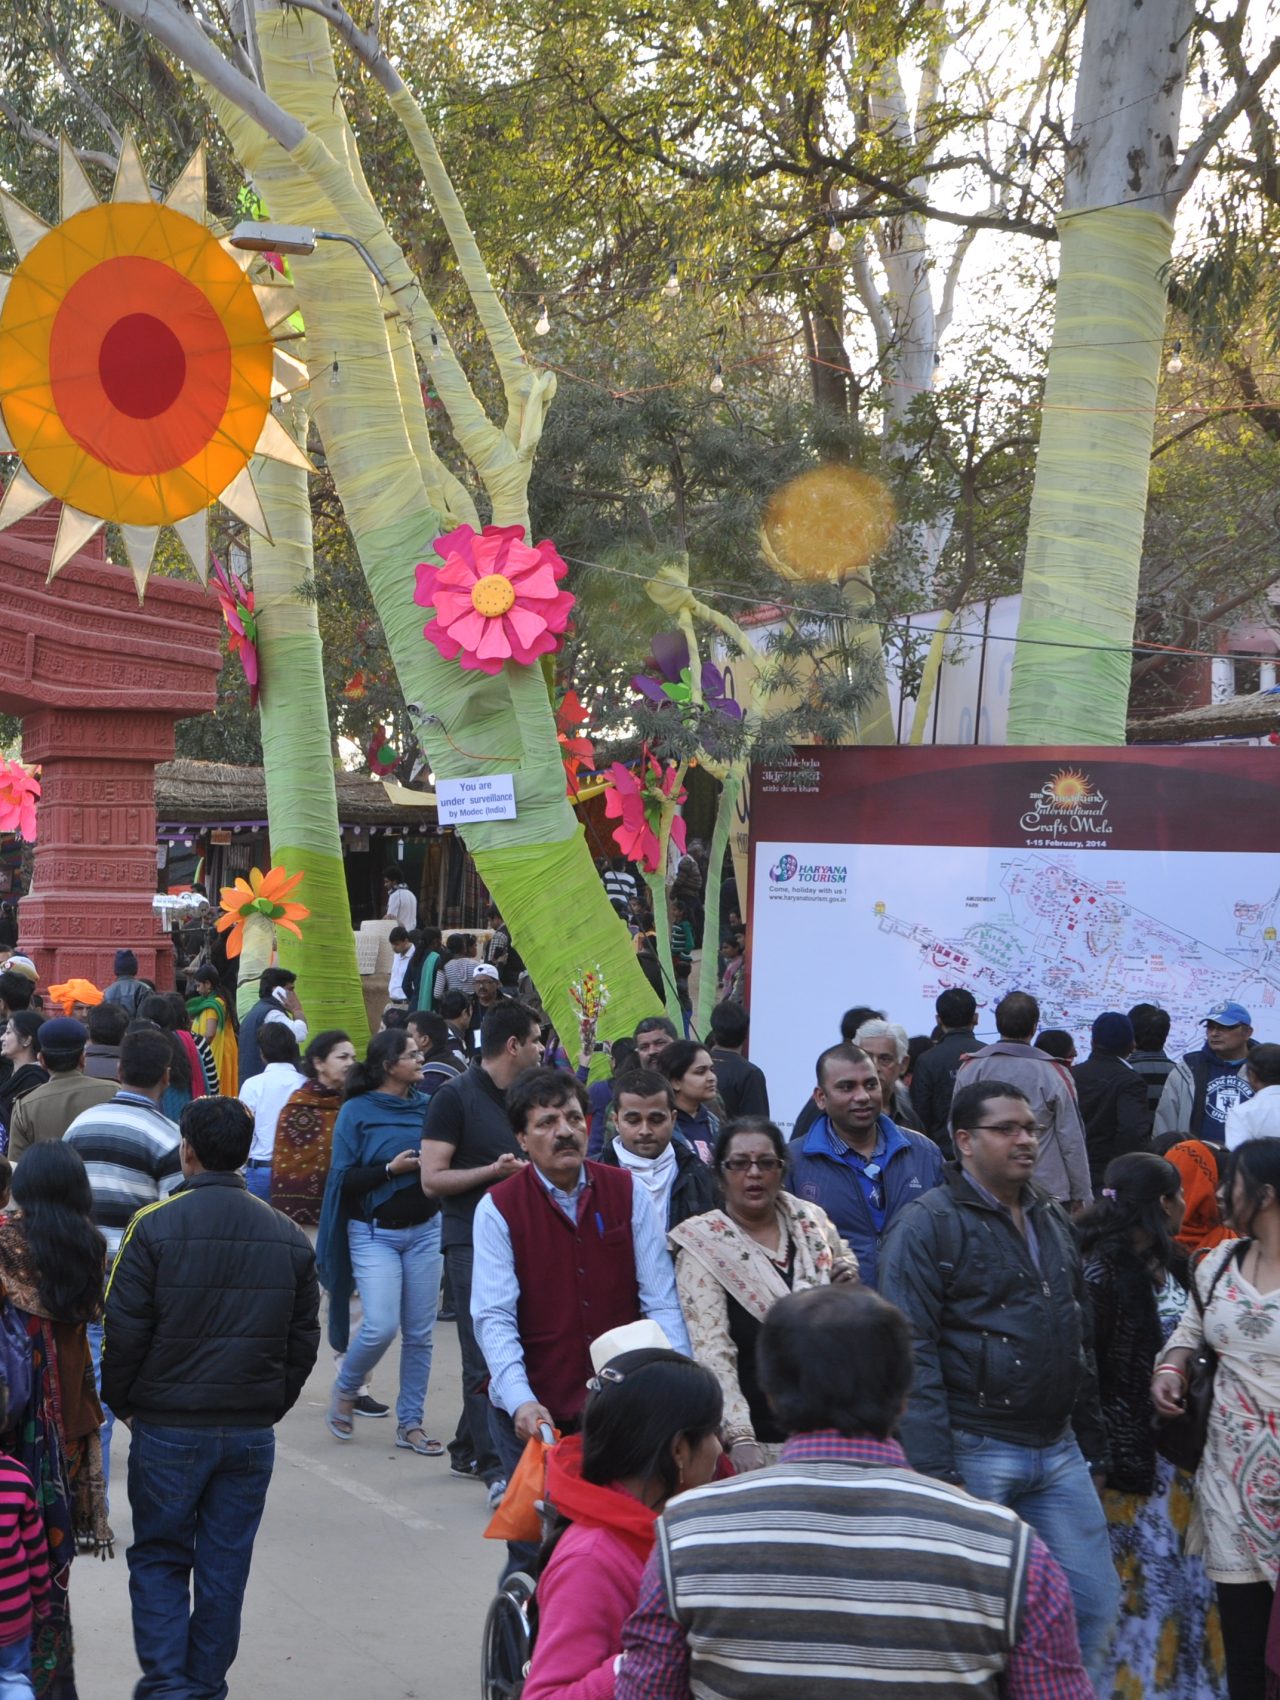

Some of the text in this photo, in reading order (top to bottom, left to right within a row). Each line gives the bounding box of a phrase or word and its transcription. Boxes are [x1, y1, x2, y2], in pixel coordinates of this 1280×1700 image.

[460, 782, 492, 792] You are
[440, 793, 513, 807] under surveillance
[449, 806, 507, 818] by Modec (India)
[1035, 799, 1108, 816] International
[1020, 812, 1113, 839] Crafts Mela
[1026, 839, 1107, 849] 1-15 February, 2014
[799, 865, 848, 875] HARYANA
[799, 873, 847, 883] TOURISM
[769, 885, 791, 893] Come,
[792, 886, 817, 894] holiday
[769, 895, 846, 904] www.haryanatourism.gov.in
